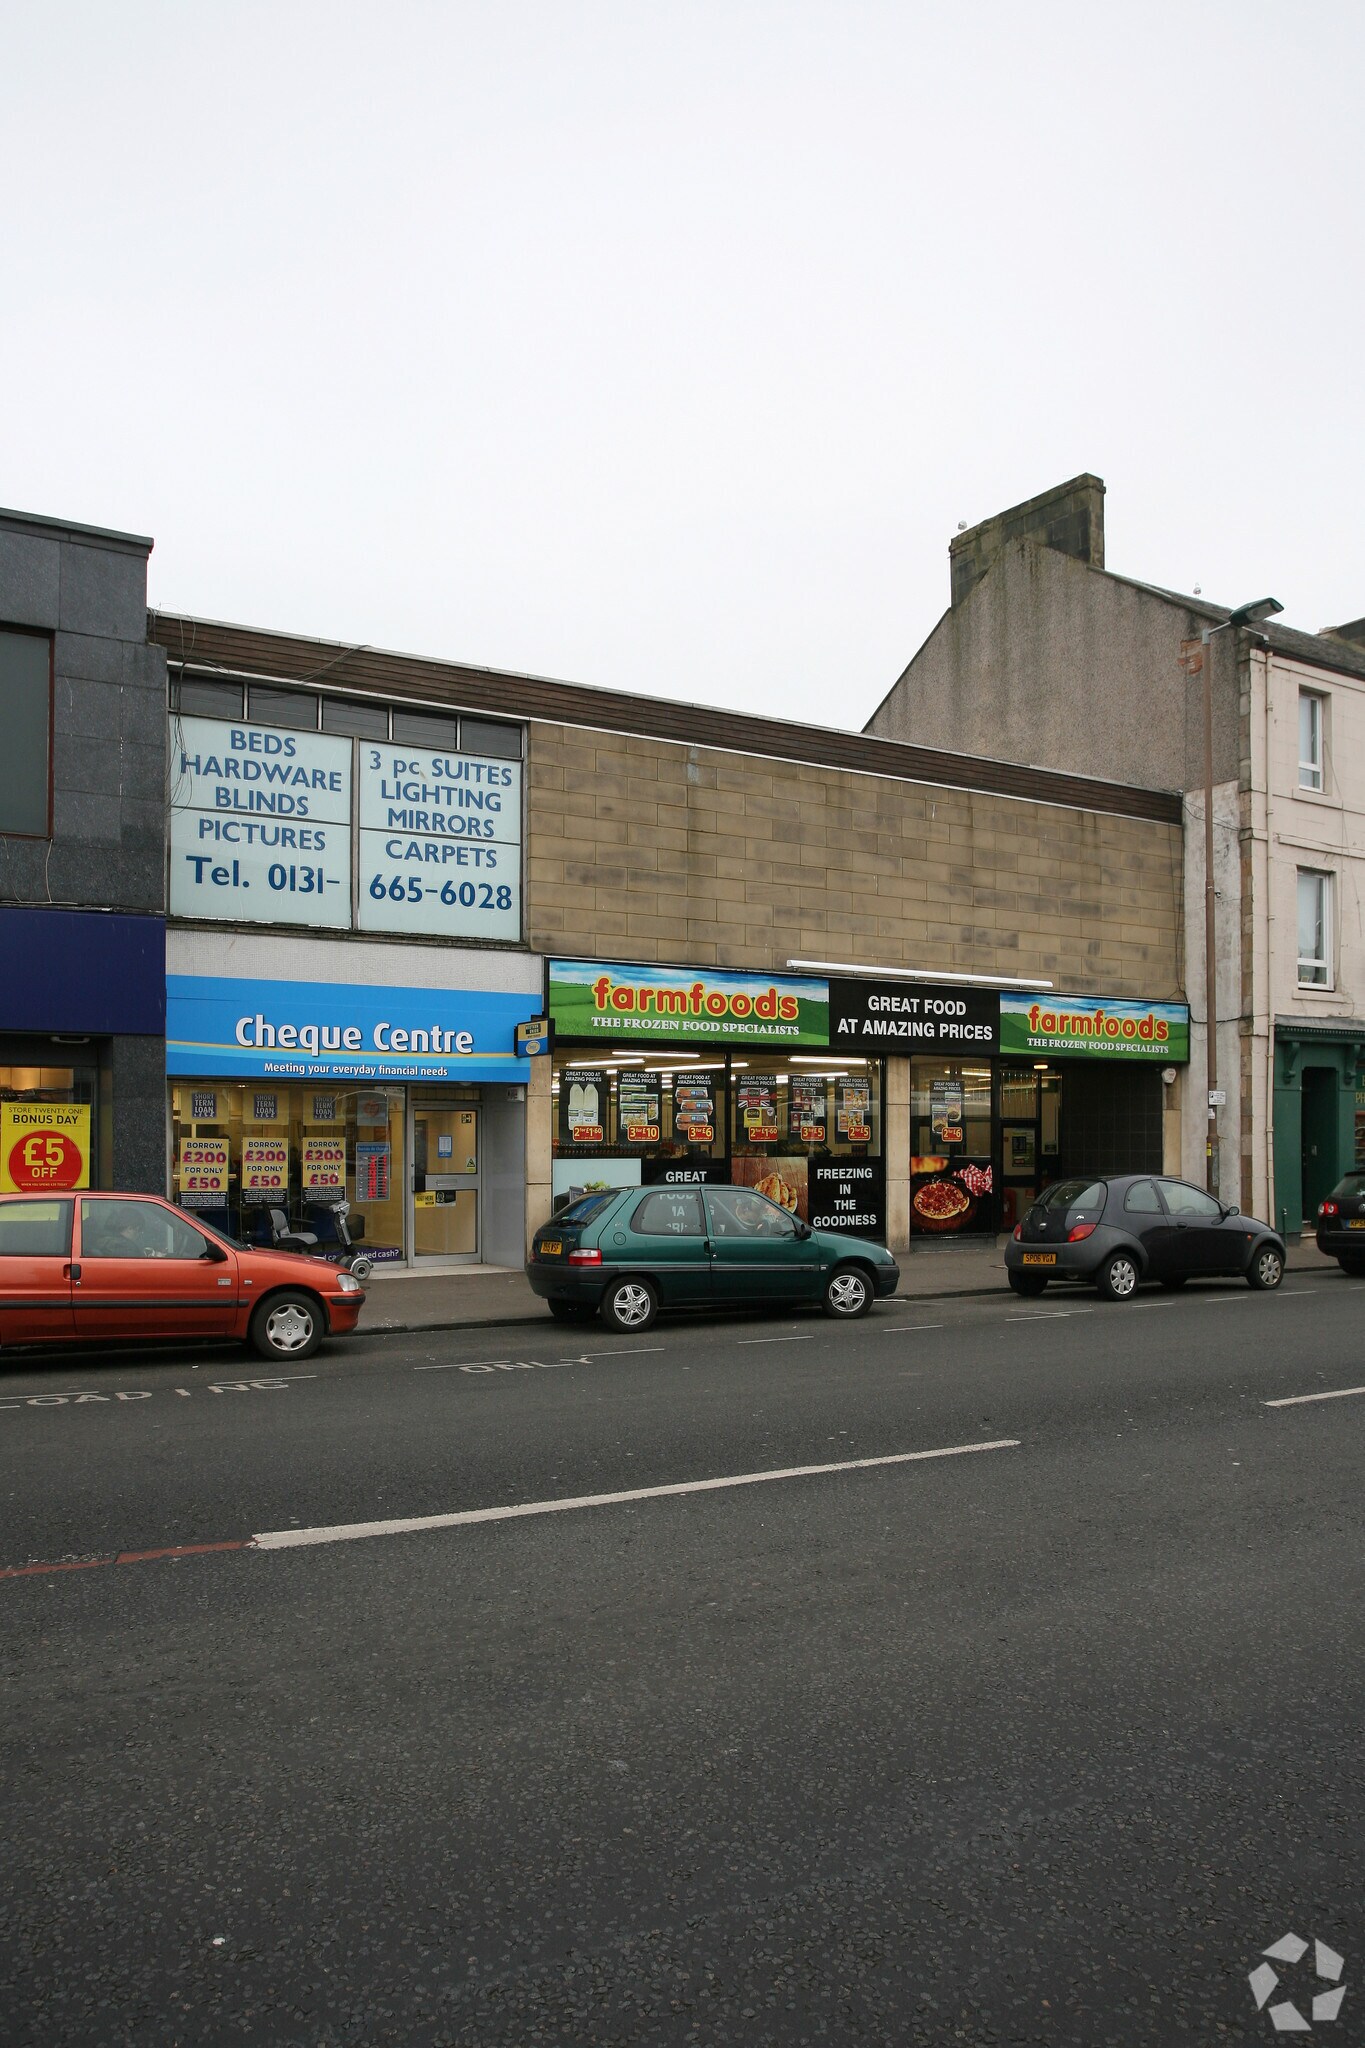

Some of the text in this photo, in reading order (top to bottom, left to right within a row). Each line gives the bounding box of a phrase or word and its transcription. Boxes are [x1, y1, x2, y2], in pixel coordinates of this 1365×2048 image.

[230, 729, 296, 757] BEDS
[181, 753, 342, 792] HARDWARE
[370, 751, 512, 787] 3 pc SUITES
[215, 787, 309, 816] BLINDS
[381, 779, 501, 812] LIGHTING
[388, 808, 494, 838] MIRRORS
[199, 818, 325, 851] PICTURES
[386, 839, 497, 868] CARPETS
[186, 855, 250, 888] Tel.
[369, 874, 512, 910] 665-6028
[592, 976, 799, 1020] farmfoods
[868, 995, 966, 1016] GREAT FOOD
[591, 1016, 800, 1035] THE FROZEN FOOD SPECIALISTS
[837, 1019, 993, 1040] AT AMAZING PRICES
[1028, 1004, 1169, 1042] farmfoods
[236, 1014, 473, 1056] Cheque Centre
[1027, 1038, 1169, 1054] THE FROZEN FOOD SPECIALISTS
[264, 1062, 448, 1077] Meeting your everyday financial needs
[13, 1114, 79, 1124] BONUS DAY
[574, 1128, 580, 1137] 2
[630, 1127, 636, 1137] 3
[643, 1127, 657, 1137] £10
[690, 1127, 696, 1137] 3
[702, 1127, 712, 1137] £6
[750, 1128, 756, 1137] 2
[803, 1127, 808, 1137] 3
[814, 1127, 823, 1137] £5
[850, 1127, 855, 1136] 2
[860, 1127, 869, 1136] £5
[943, 1129, 948, 1138] 2
[23, 1138, 64, 1166] £5
[183, 1151, 227, 1164] £200
[244, 1150, 286, 1162] £200
[305, 1150, 344, 1161] £200
[31, 1167, 57, 1178] OFF
[665, 1171, 707, 1182] GREAT
[817, 1168, 873, 1180] FREEZING
[187, 1177, 220, 1189] £50
[250, 1175, 281, 1187] £50
[309, 1174, 339, 1185] £50
[839, 1184, 851, 1195] IN
[834, 1200, 856, 1210] THE
[813, 1214, 877, 1227] GOODNESS
[377, 1249, 399, 1258] cash?
[458, 1355, 595, 1374] ONLY
